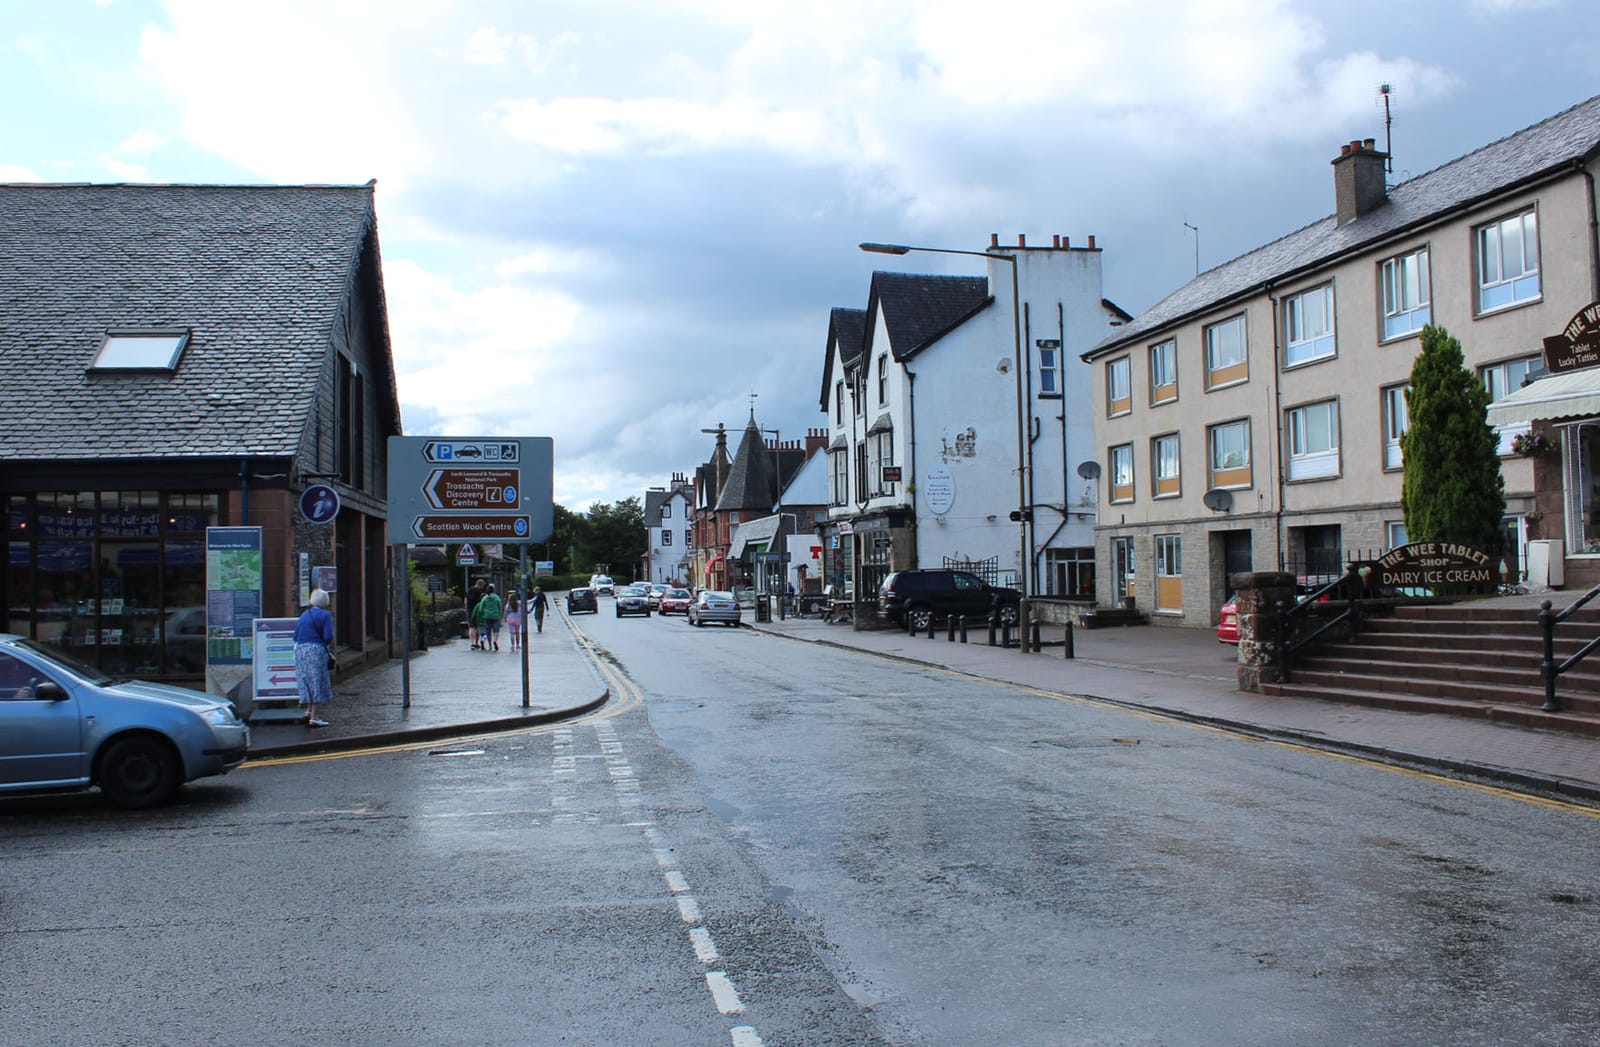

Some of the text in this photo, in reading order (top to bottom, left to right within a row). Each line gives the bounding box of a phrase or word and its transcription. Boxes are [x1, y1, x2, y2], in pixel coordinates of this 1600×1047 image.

[1564, 317, 1586, 342] THE
[1569, 343, 1591, 354] Tablet
[1558, 357, 1576, 367] Lucky
[440, 446, 497, 458] P WC
[446, 482, 485, 490] Trossachs
[446, 490, 484, 499] Discovery
[427, 523, 512, 531] Scottish Wool Centre
[1378, 543, 1489, 569] THE WEE TABLET
[1420, 558, 1450, 567] SHOP
[1383, 569, 1490, 585] DAIRY ICE CREAM
